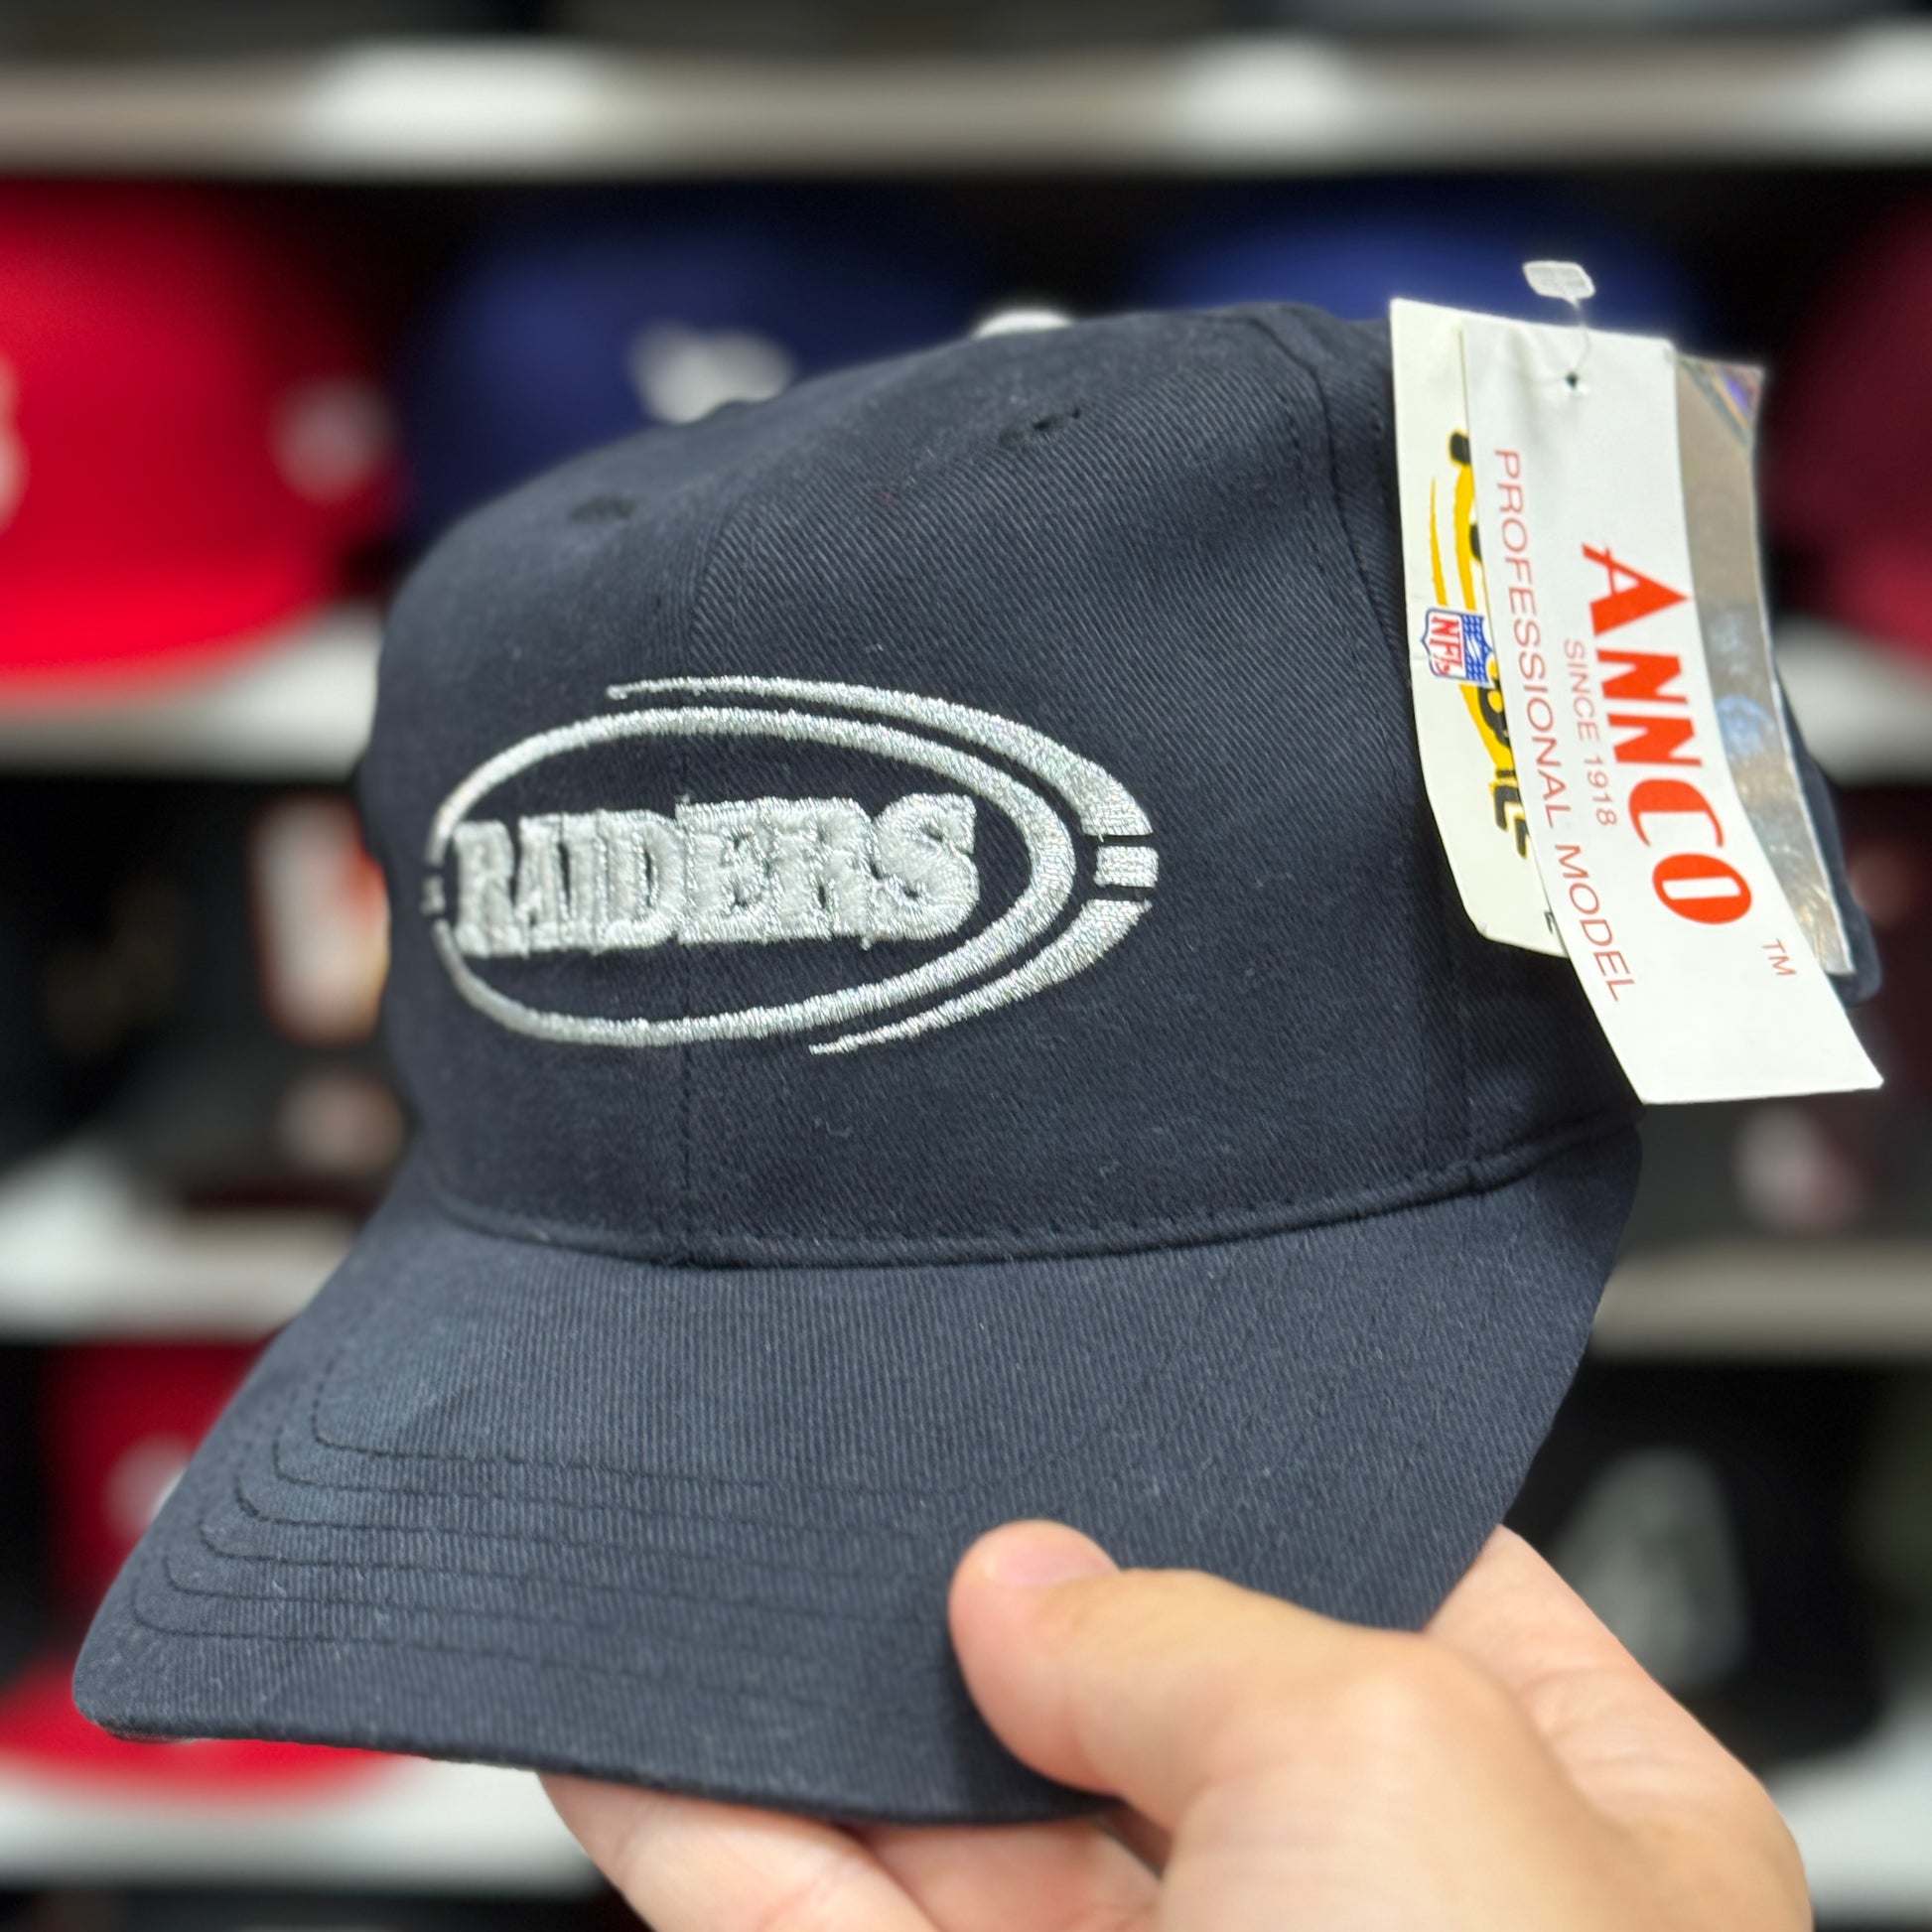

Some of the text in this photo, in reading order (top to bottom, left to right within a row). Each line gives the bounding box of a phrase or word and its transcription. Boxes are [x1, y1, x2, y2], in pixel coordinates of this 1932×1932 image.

[1493, 449, 1636, 1001] PROFESSIONAL MODEL
[1564, 639, 1618, 826] SINCE 1918
[1581, 542, 1754, 926] ANNCO
[454, 794, 980, 956] RAIDERS
